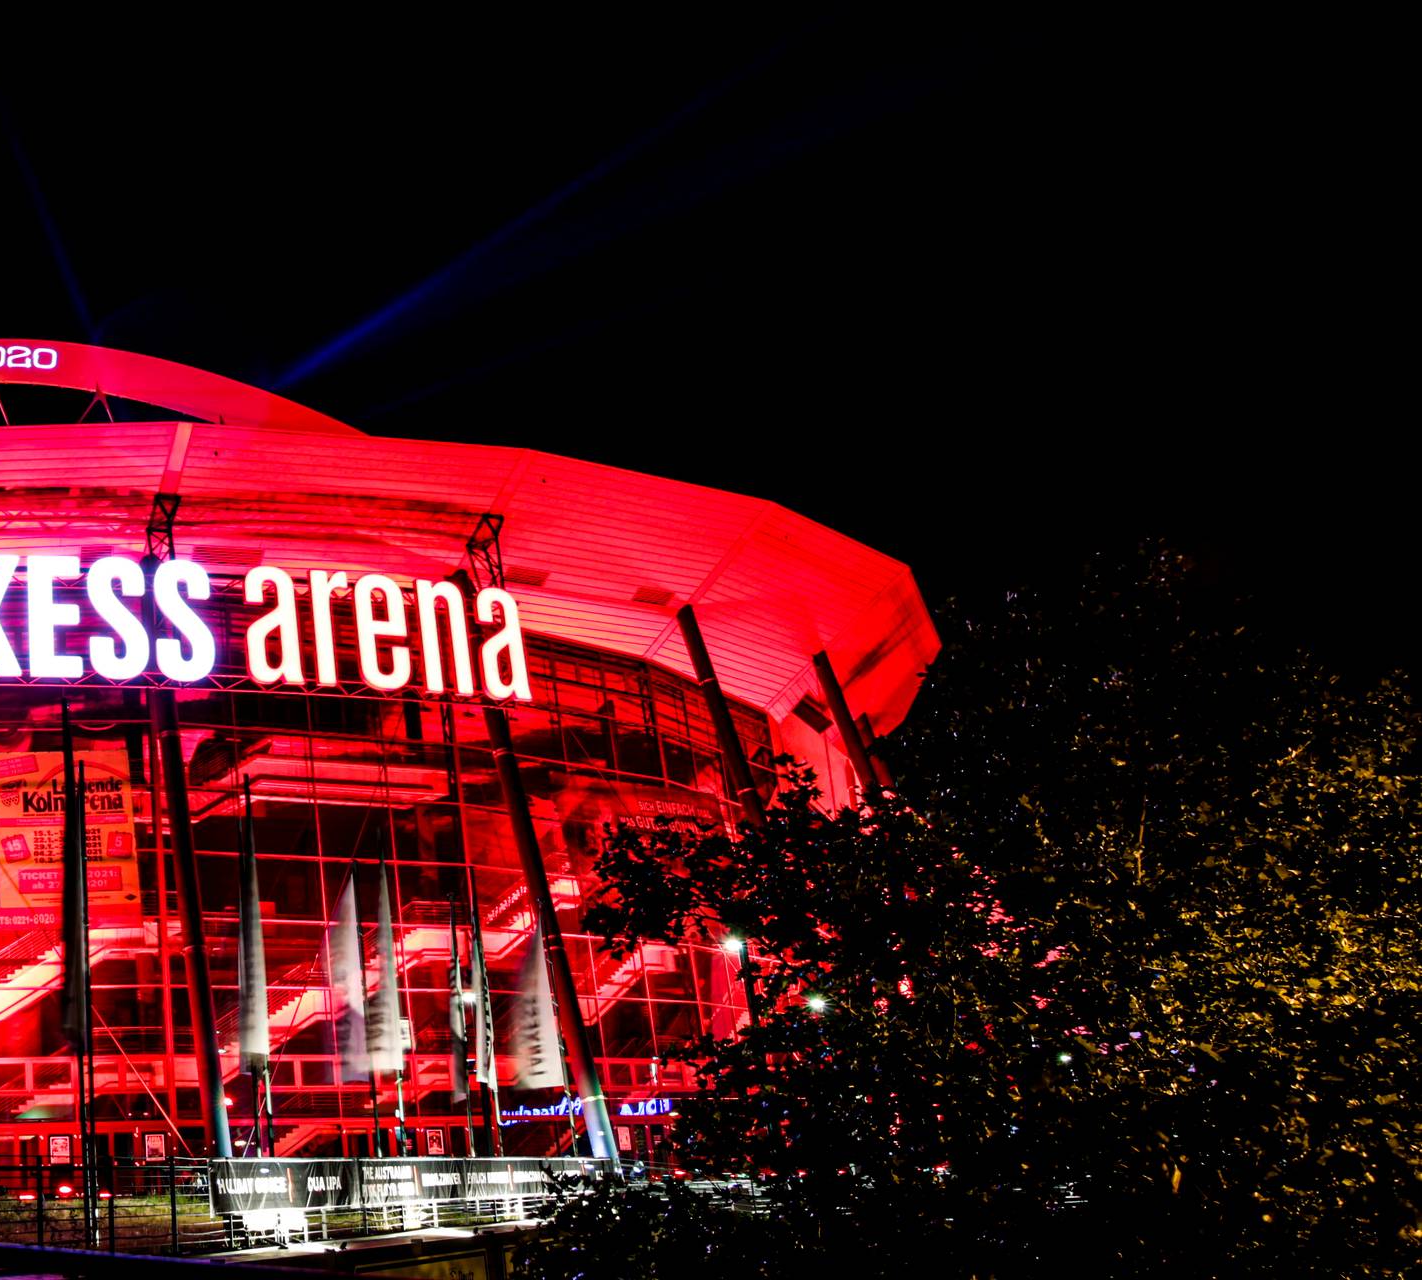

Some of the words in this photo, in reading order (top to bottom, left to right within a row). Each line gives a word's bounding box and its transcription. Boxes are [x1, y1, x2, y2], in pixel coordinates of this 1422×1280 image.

[244, 565, 533, 701] arena
[52, 777, 123, 794] Lende
[22, 791, 124, 813] Kölnena
[656, 801, 695, 816] EINFACH
[326, 1176, 342, 1190] LIPA
